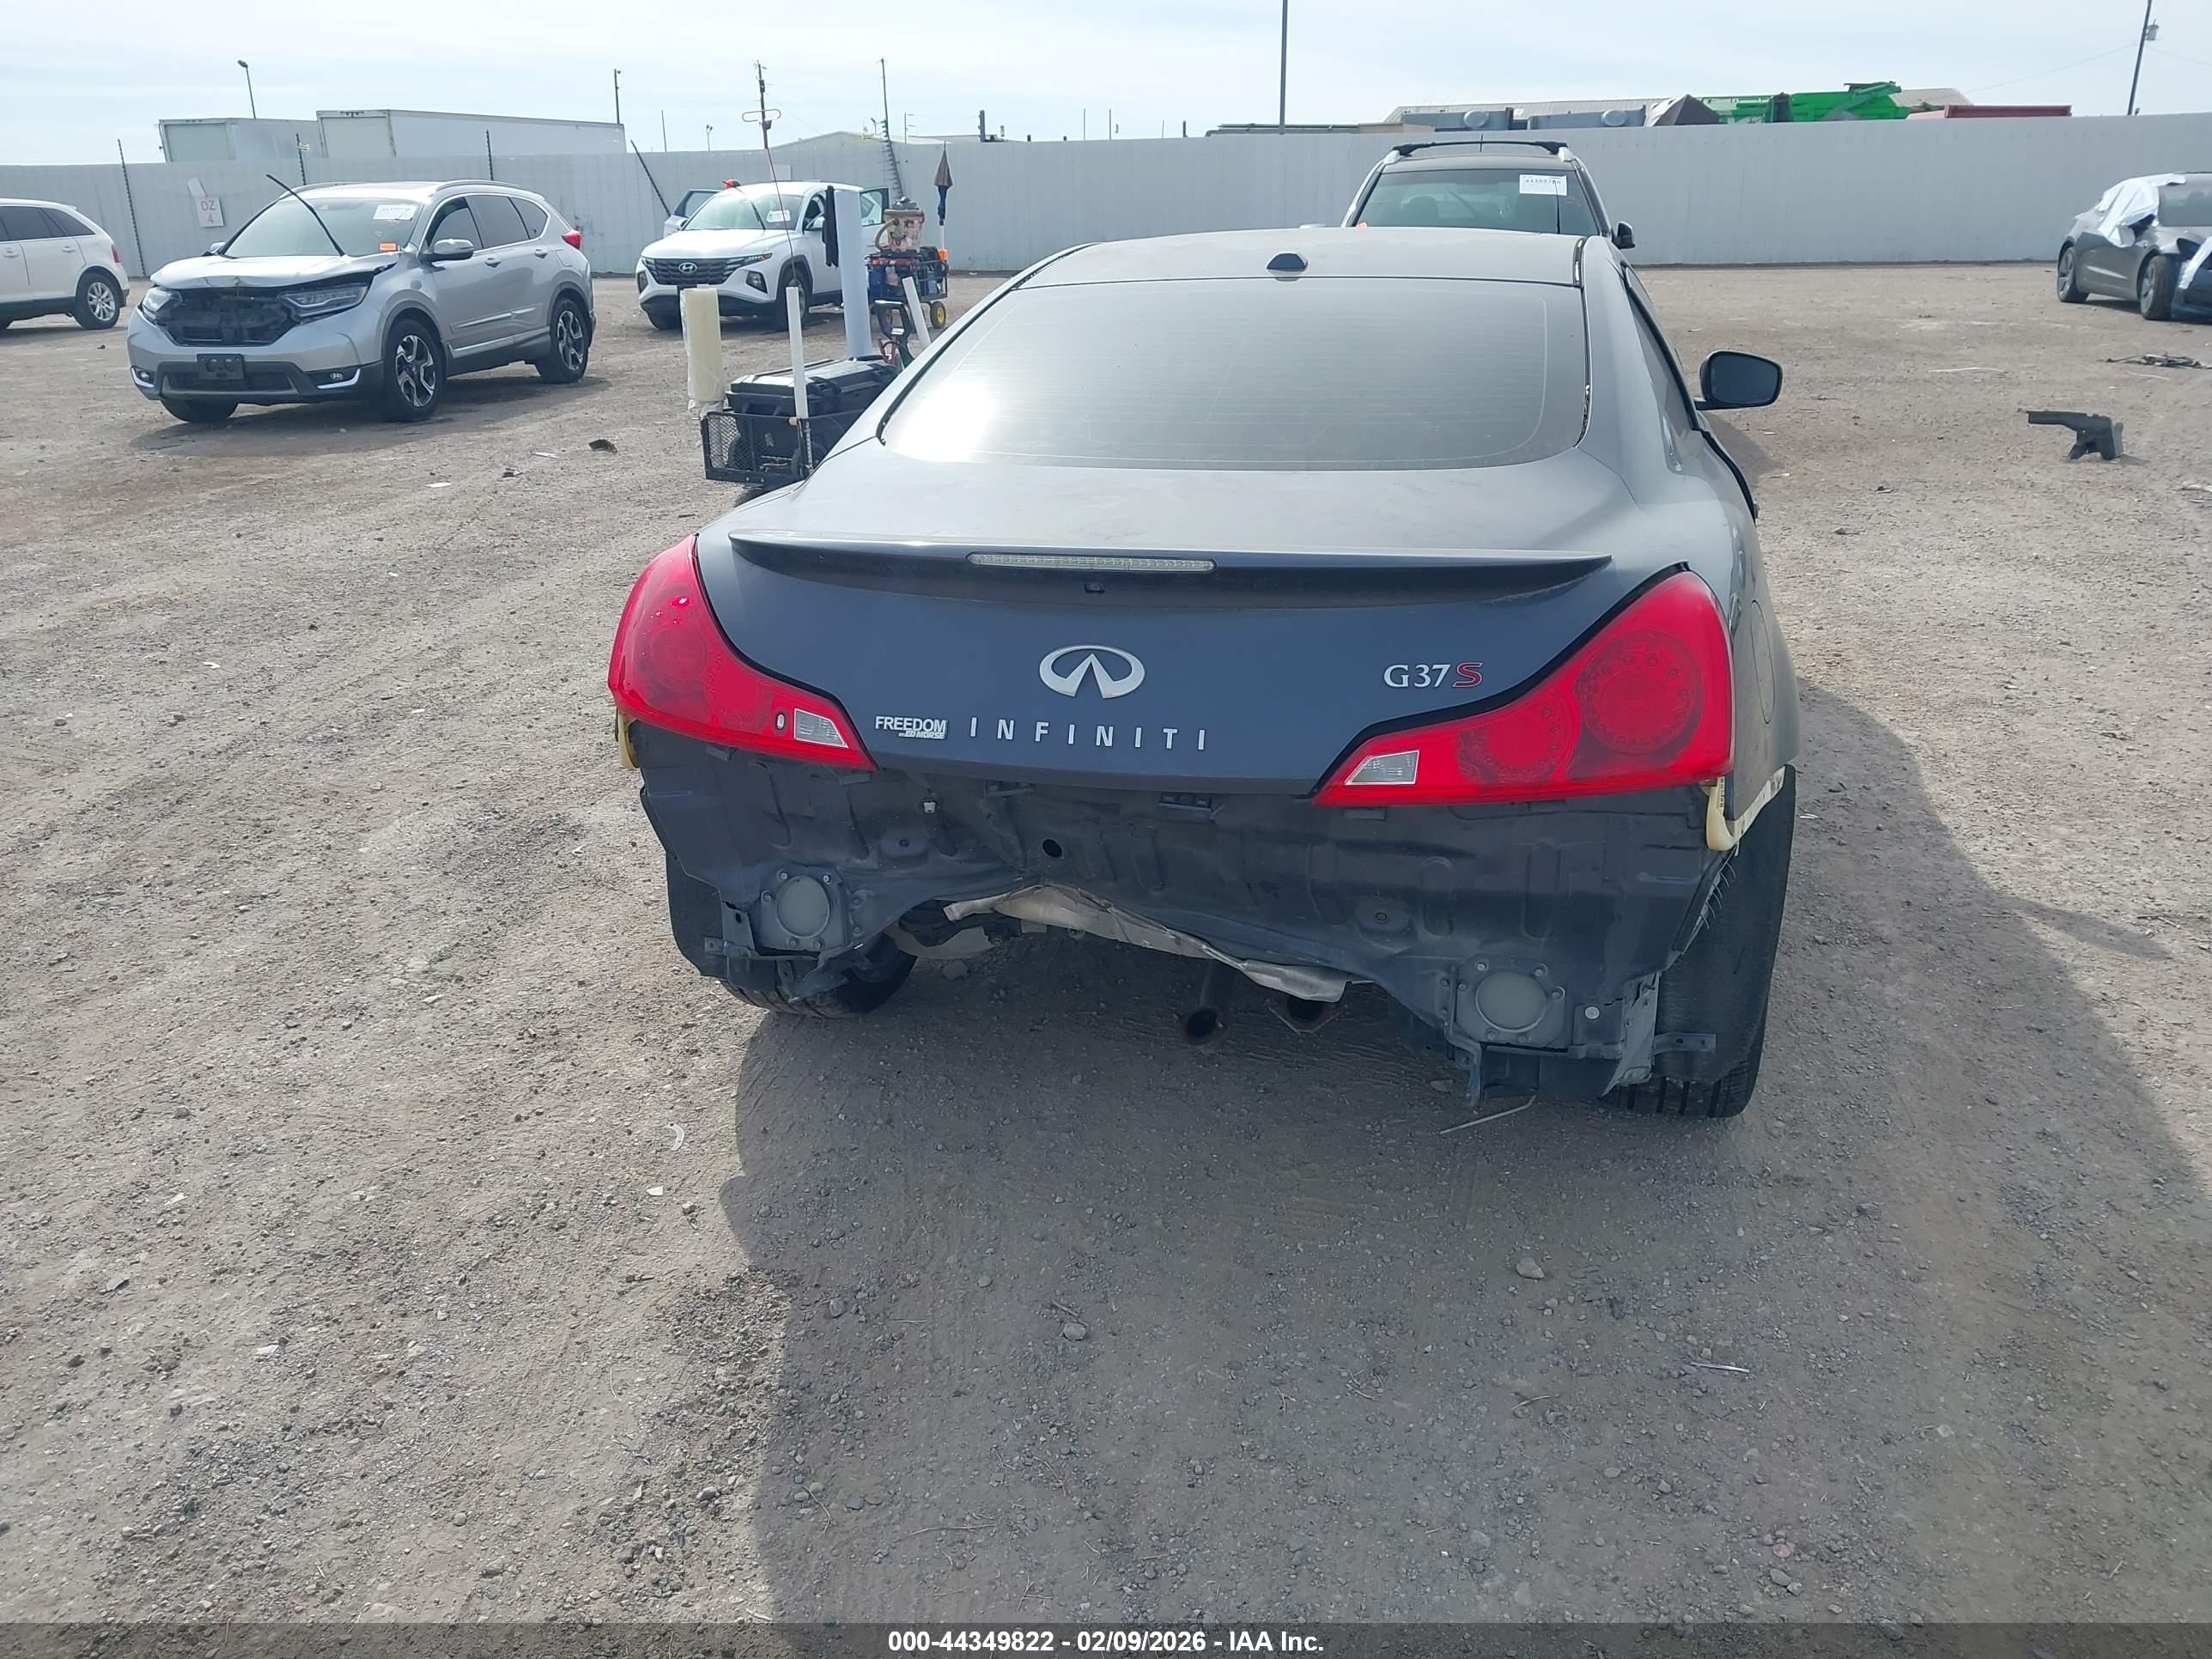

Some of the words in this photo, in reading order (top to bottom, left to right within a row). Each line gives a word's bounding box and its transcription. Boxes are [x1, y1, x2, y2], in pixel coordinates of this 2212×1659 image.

[207, 214, 214, 224] 4
[875, 715, 948, 732] FREEDOM
[916, 731, 945, 739] MORSE
[969, 716, 1206, 750] INFINITI
